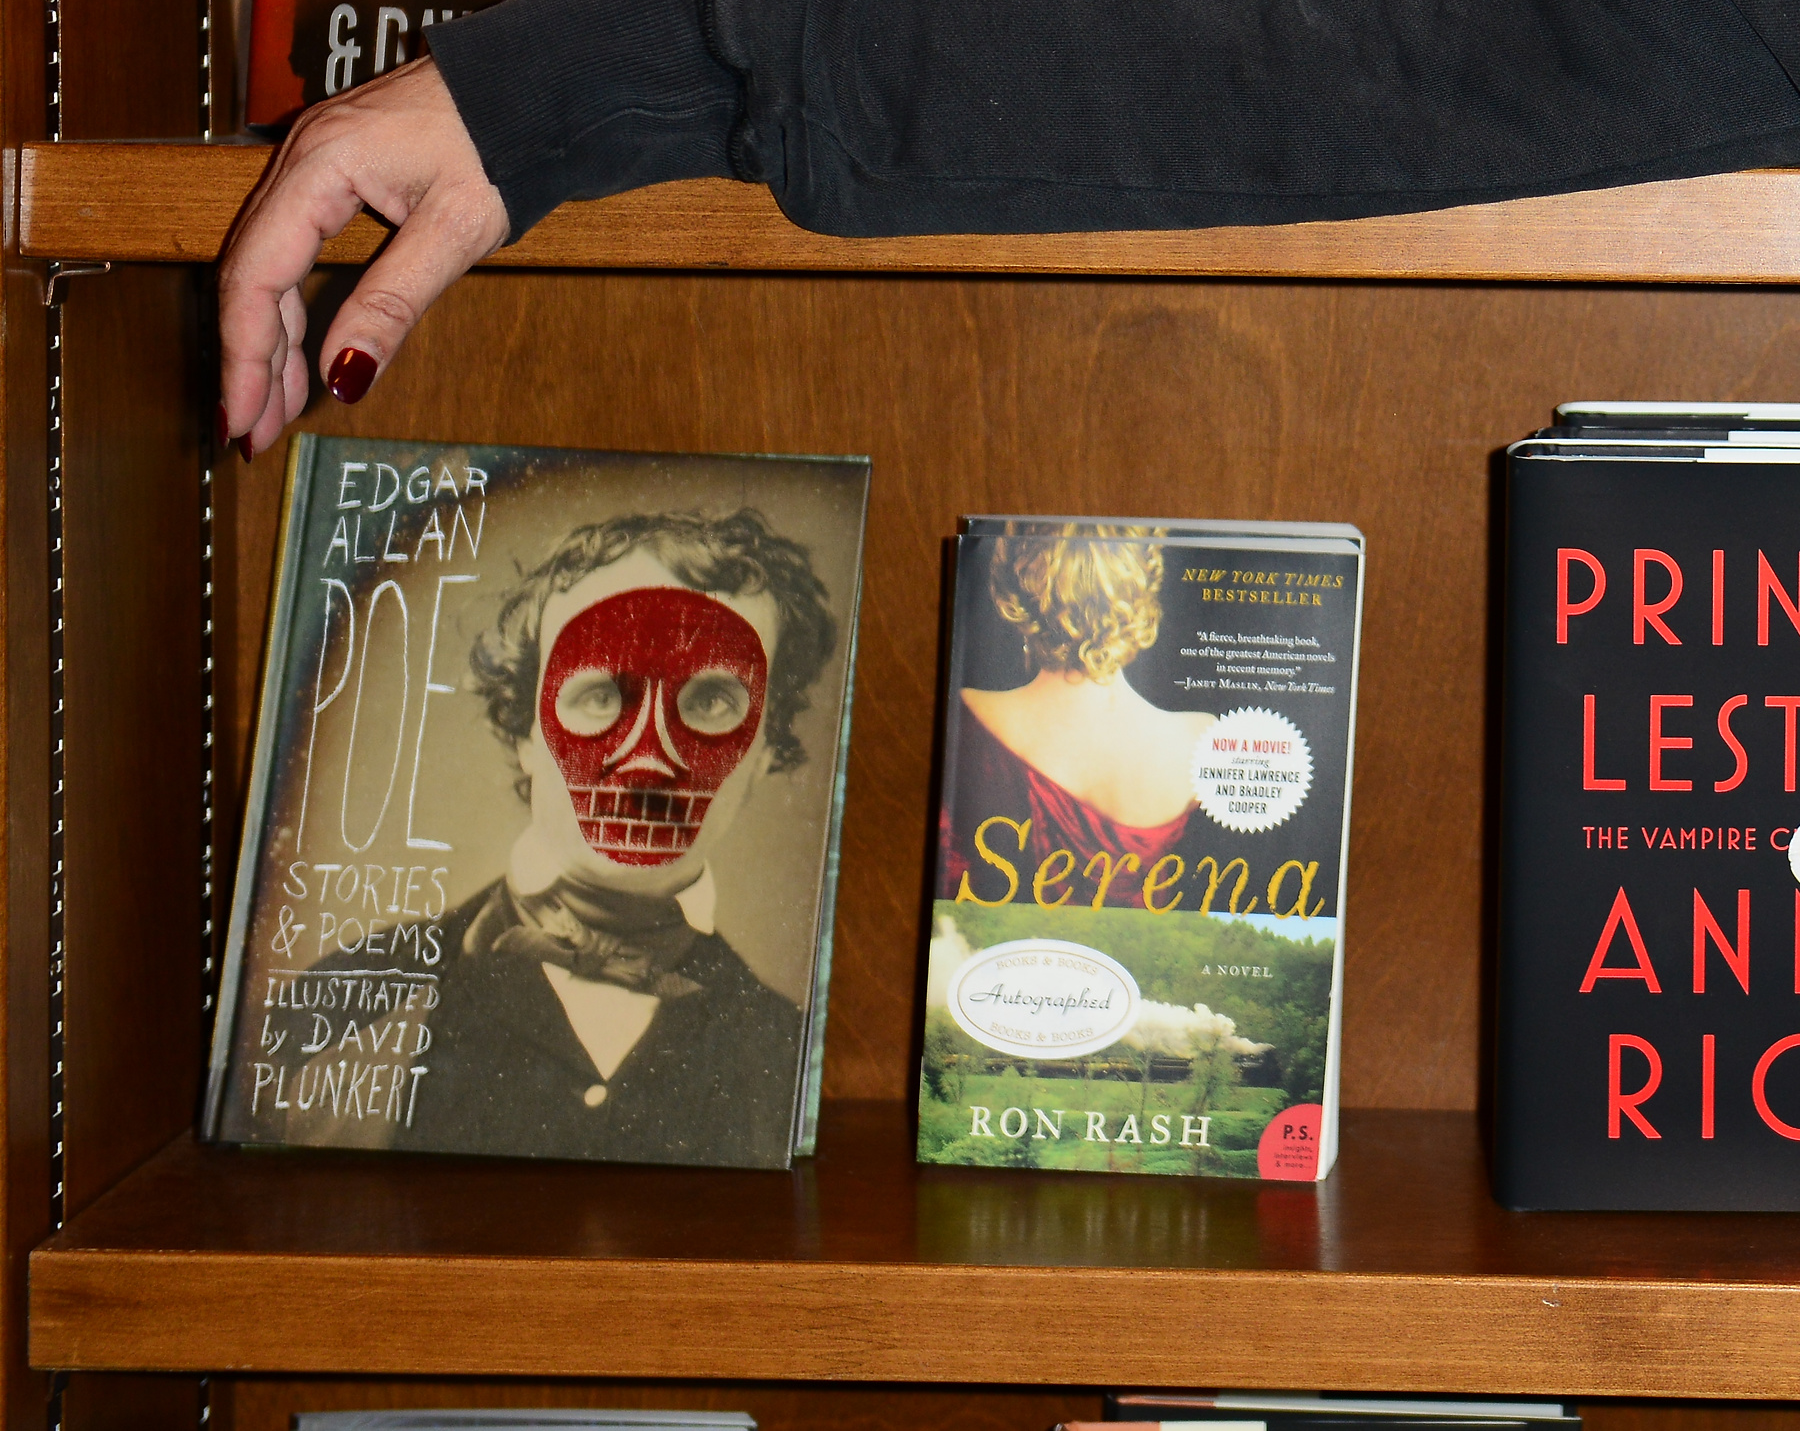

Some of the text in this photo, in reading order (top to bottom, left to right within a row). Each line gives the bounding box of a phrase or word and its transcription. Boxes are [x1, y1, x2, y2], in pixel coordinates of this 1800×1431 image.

[325, 3, 361, 97] &
[337, 462, 488, 512] EDGAR
[323, 501, 486, 568] ALLAN
[1181, 569, 1344, 589] NEW YORK TIMES
[1202, 588, 1322, 606] BESTSELLER
[1209, 632, 1237, 645] fierce,
[1237, 633, 1295, 648] breathtaking
[1295, 636, 1320, 647] book,
[1180, 646, 1335, 662] one of the greatest American novels
[1216, 662, 1226, 672] in
[1226, 664, 1255, 673] recent
[1264, 681, 1287, 691] New
[1287, 681, 1307, 692] York
[1307, 682, 1335, 694] Times
[297, 574, 480, 854] POE
[1212, 738, 1292, 754] NOW A MOVIE!
[1199, 767, 1300, 783] JENNIFER LAWRENCE
[1215, 784, 1282, 798] AND BRADLEY
[1228, 801, 1267, 814] COOPER
[1582, 826, 1629, 849] THE
[1641, 827, 1757, 850] VAMPIRE
[957, 815, 1327, 920] Serena
[283, 861, 448, 920] STORIES
[271, 904, 443, 966] & POEMS
[996, 956, 1038, 970] BOOKS
[1058, 957, 1098, 976] BOOKS
[1201, 964, 1273, 978] A NOVEL
[264, 977, 441, 1012] ILLUSTRATED
[969, 983, 1114, 1015] Autographed
[261, 1013, 432, 1057] by DAVID
[990, 1022, 1031, 1040] BOOKS
[1051, 1028, 1094, 1042] BOOKS
[252, 1060, 429, 1128] PLUNKERT
[969, 1105, 1212, 1147] RON RASH
[1283, 1124, 1313, 1141] P.S.
